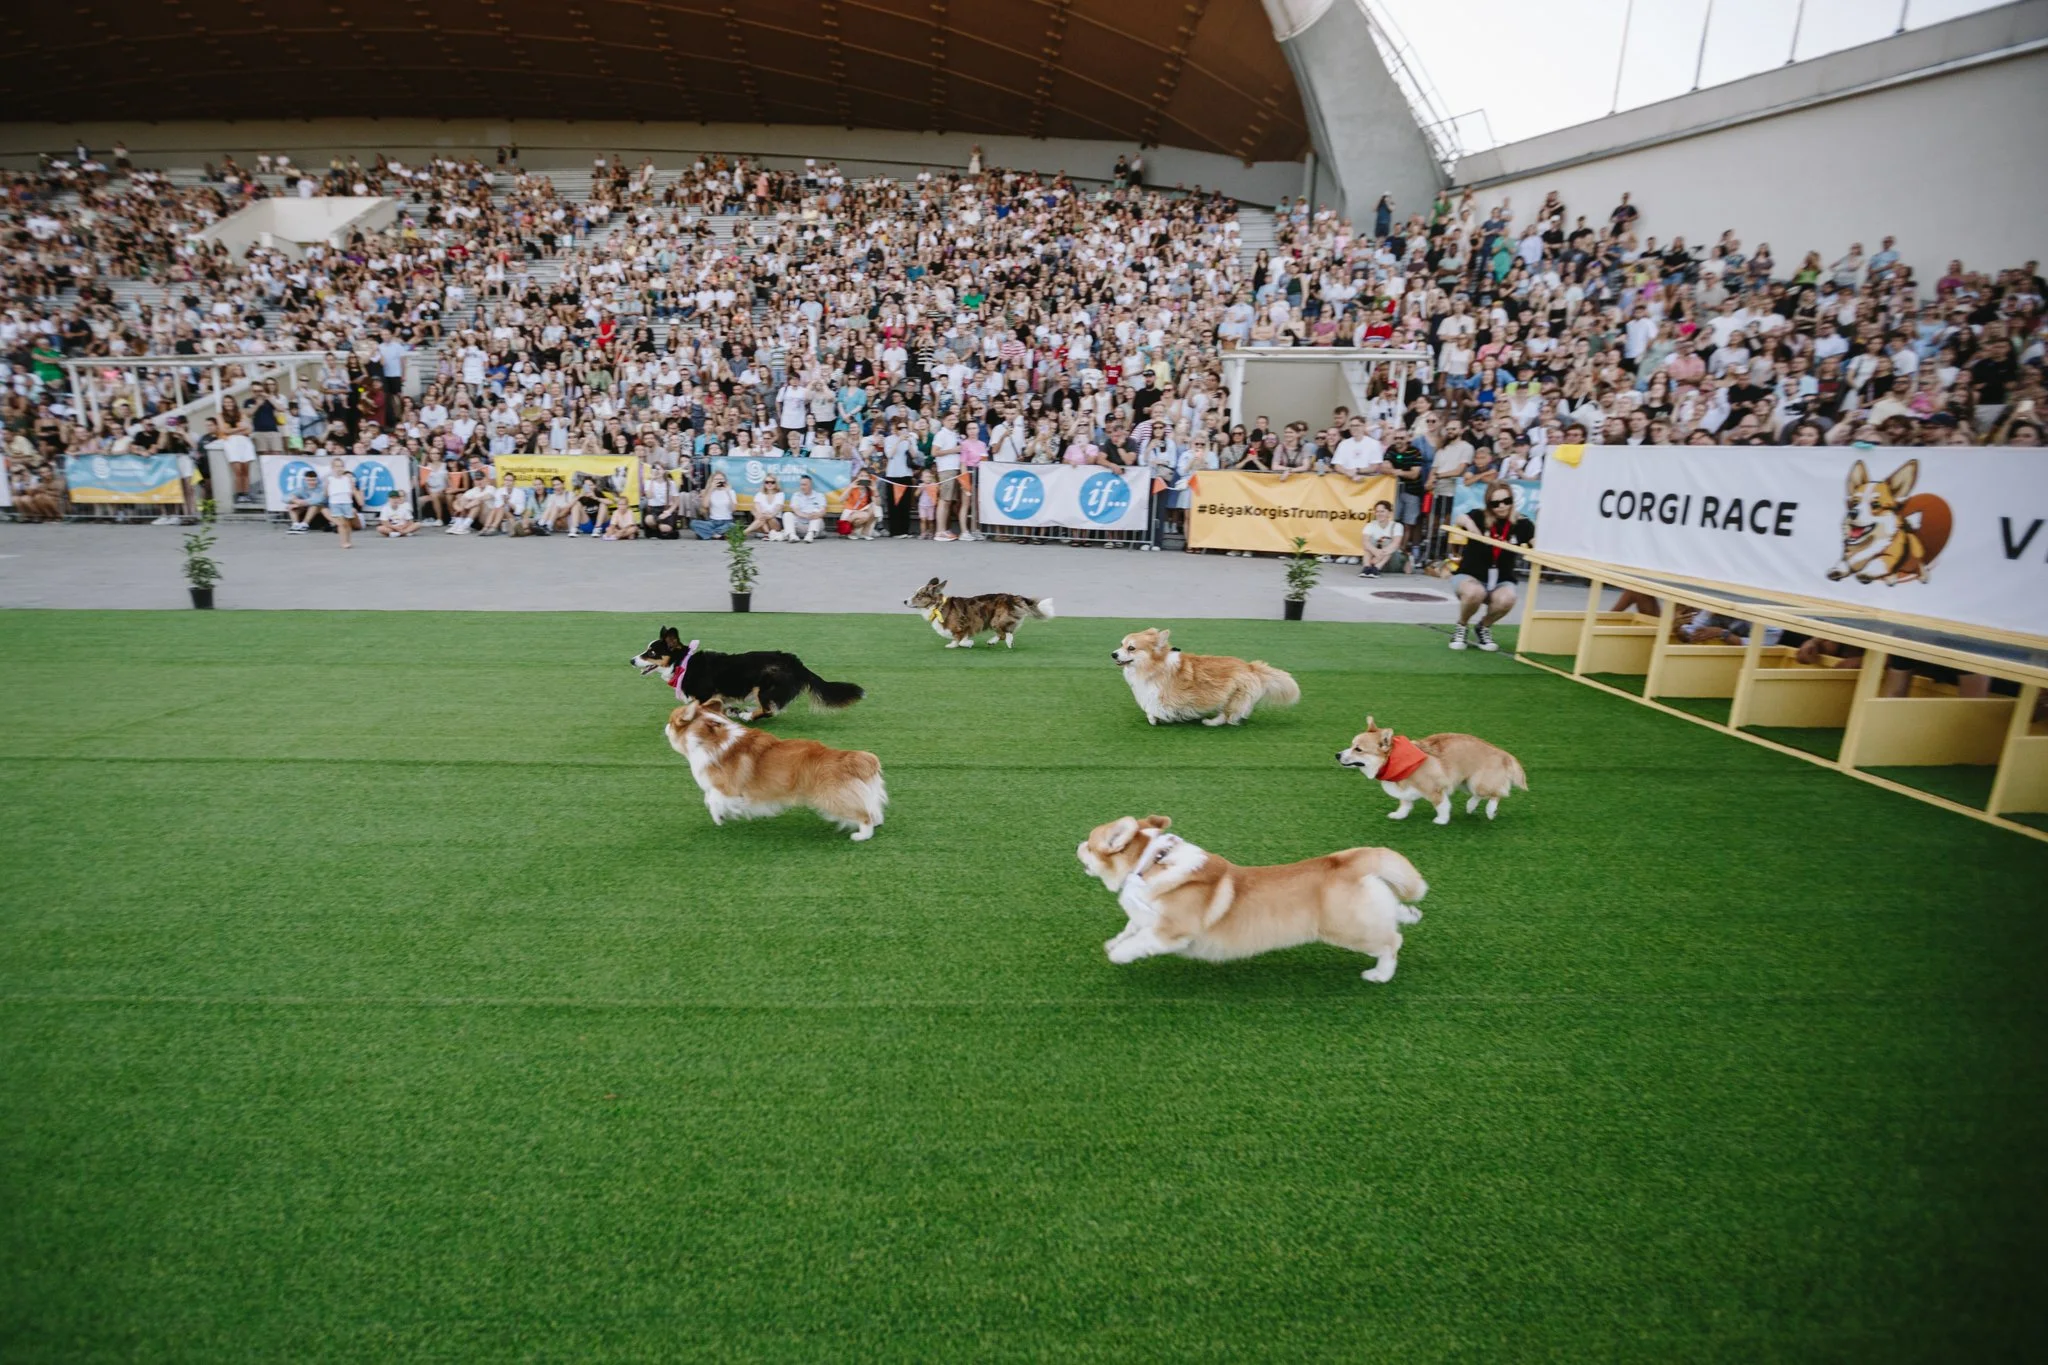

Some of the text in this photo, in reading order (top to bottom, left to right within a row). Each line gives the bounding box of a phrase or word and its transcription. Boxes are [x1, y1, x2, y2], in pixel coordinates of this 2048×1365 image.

[1197, 503, 1372, 523] #BėgaKorgisTrumpakoj
[1599, 488, 1798, 537] CORGI RACE
[1999, 516, 2048, 563] V
